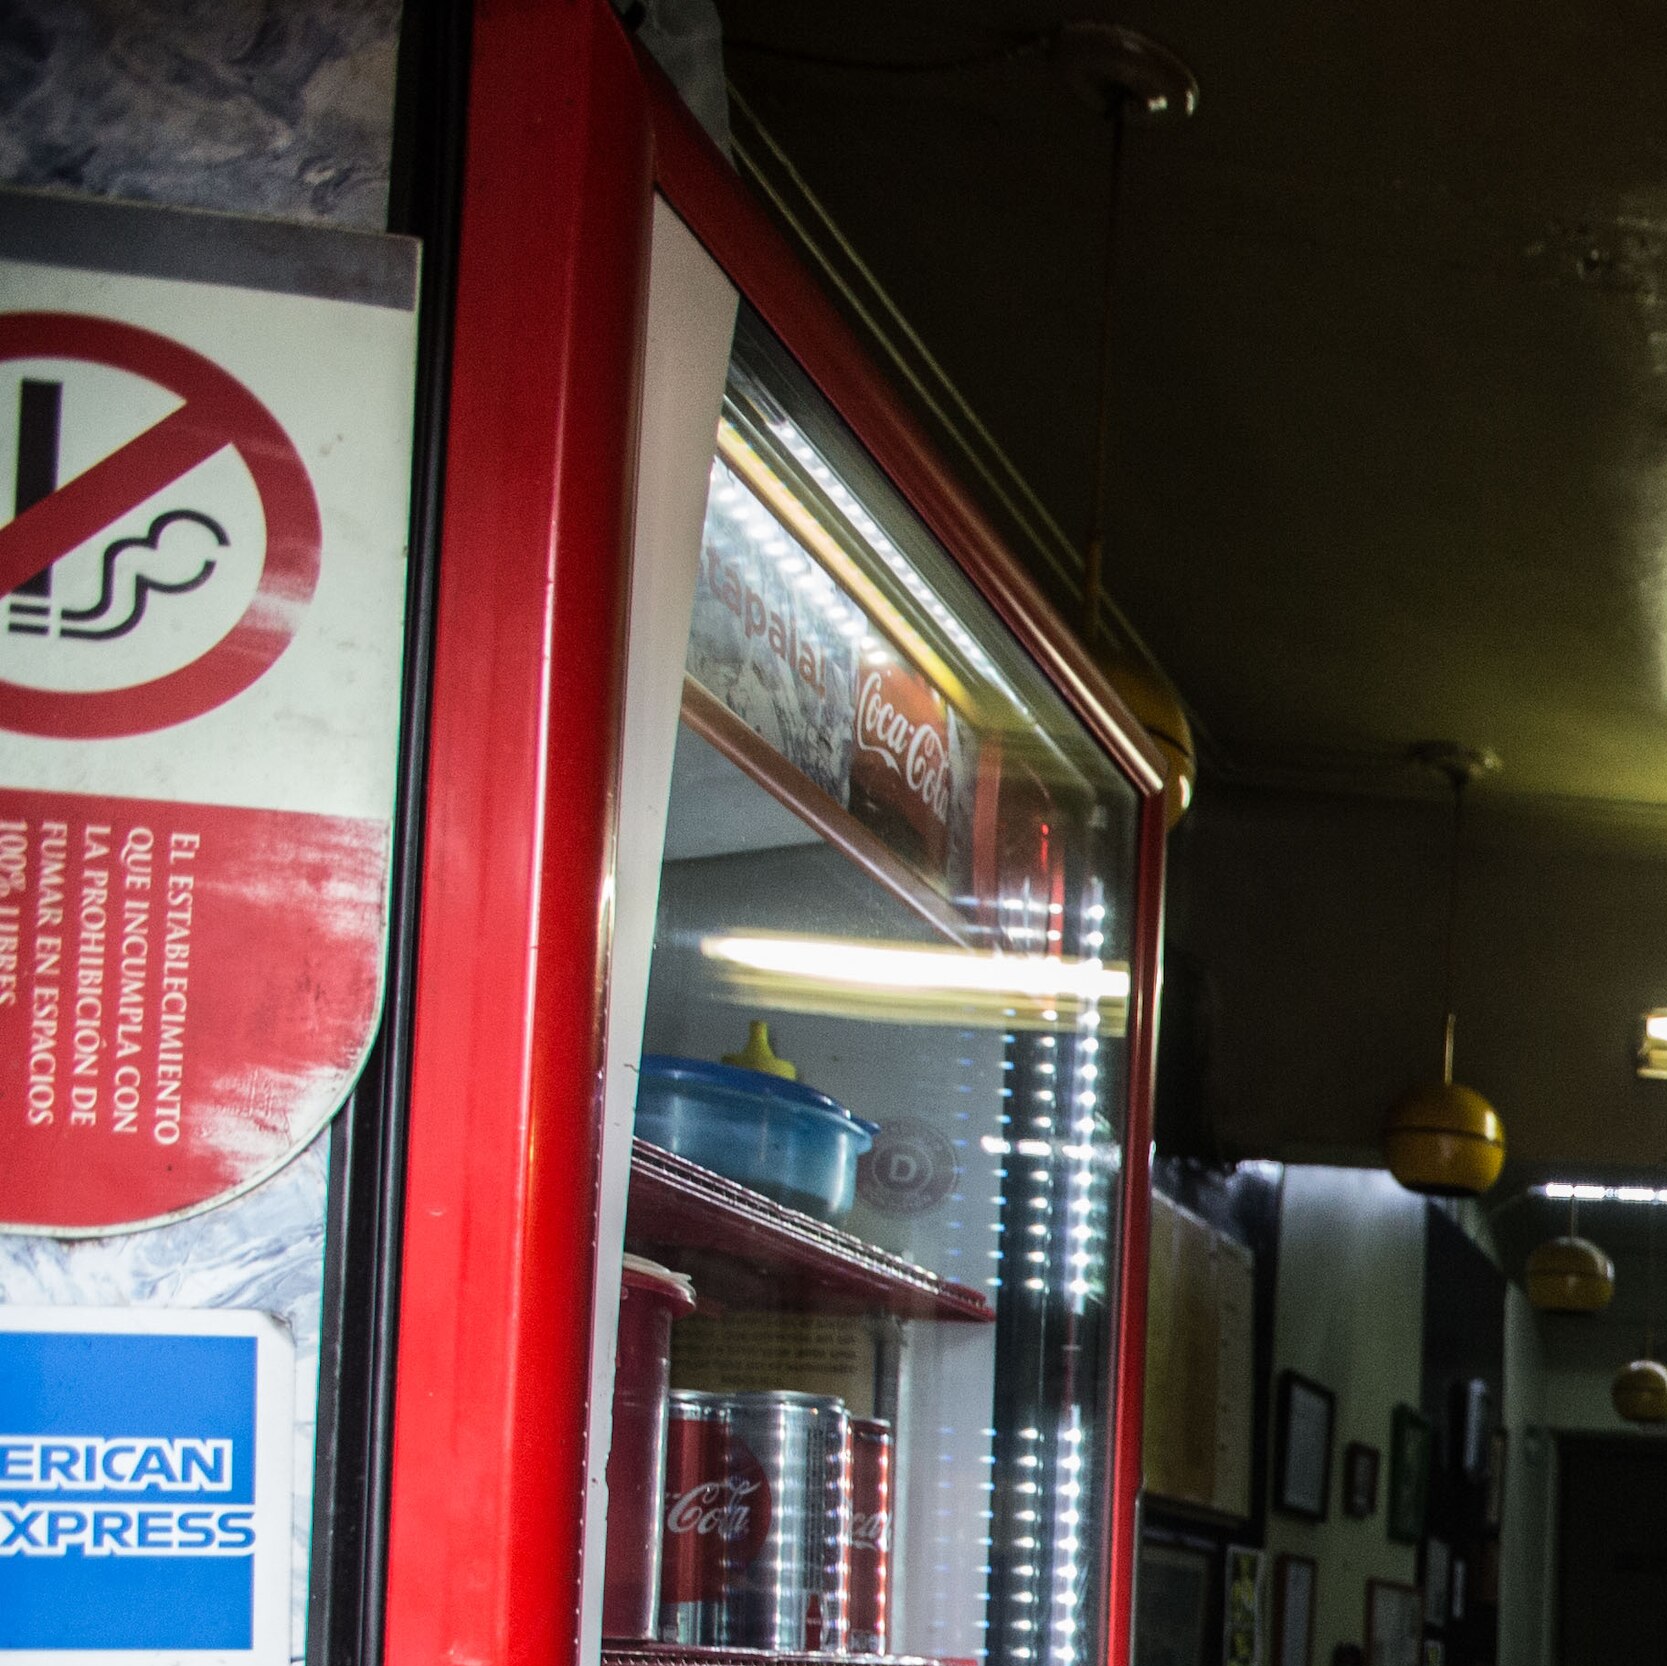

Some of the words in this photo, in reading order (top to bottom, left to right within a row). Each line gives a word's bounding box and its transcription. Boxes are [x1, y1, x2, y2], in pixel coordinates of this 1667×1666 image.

[36, 821, 68, 927] FUMAR
[84, 825, 111, 860] LA
[120, 826, 154, 891] QUE
[170, 832, 201, 864] EL
[35, 936, 62, 974] EN
[71, 869, 109, 1079] PROHIBICIÓN
[116, 900, 151, 1060] INCUMPLA
[153, 874, 196, 1146] ESTABLECIMIENTO
[27, 986, 59, 1126] ESPACIOS
[70, 1087, 98, 1127] DE
[111, 1065, 141, 1134] CON
